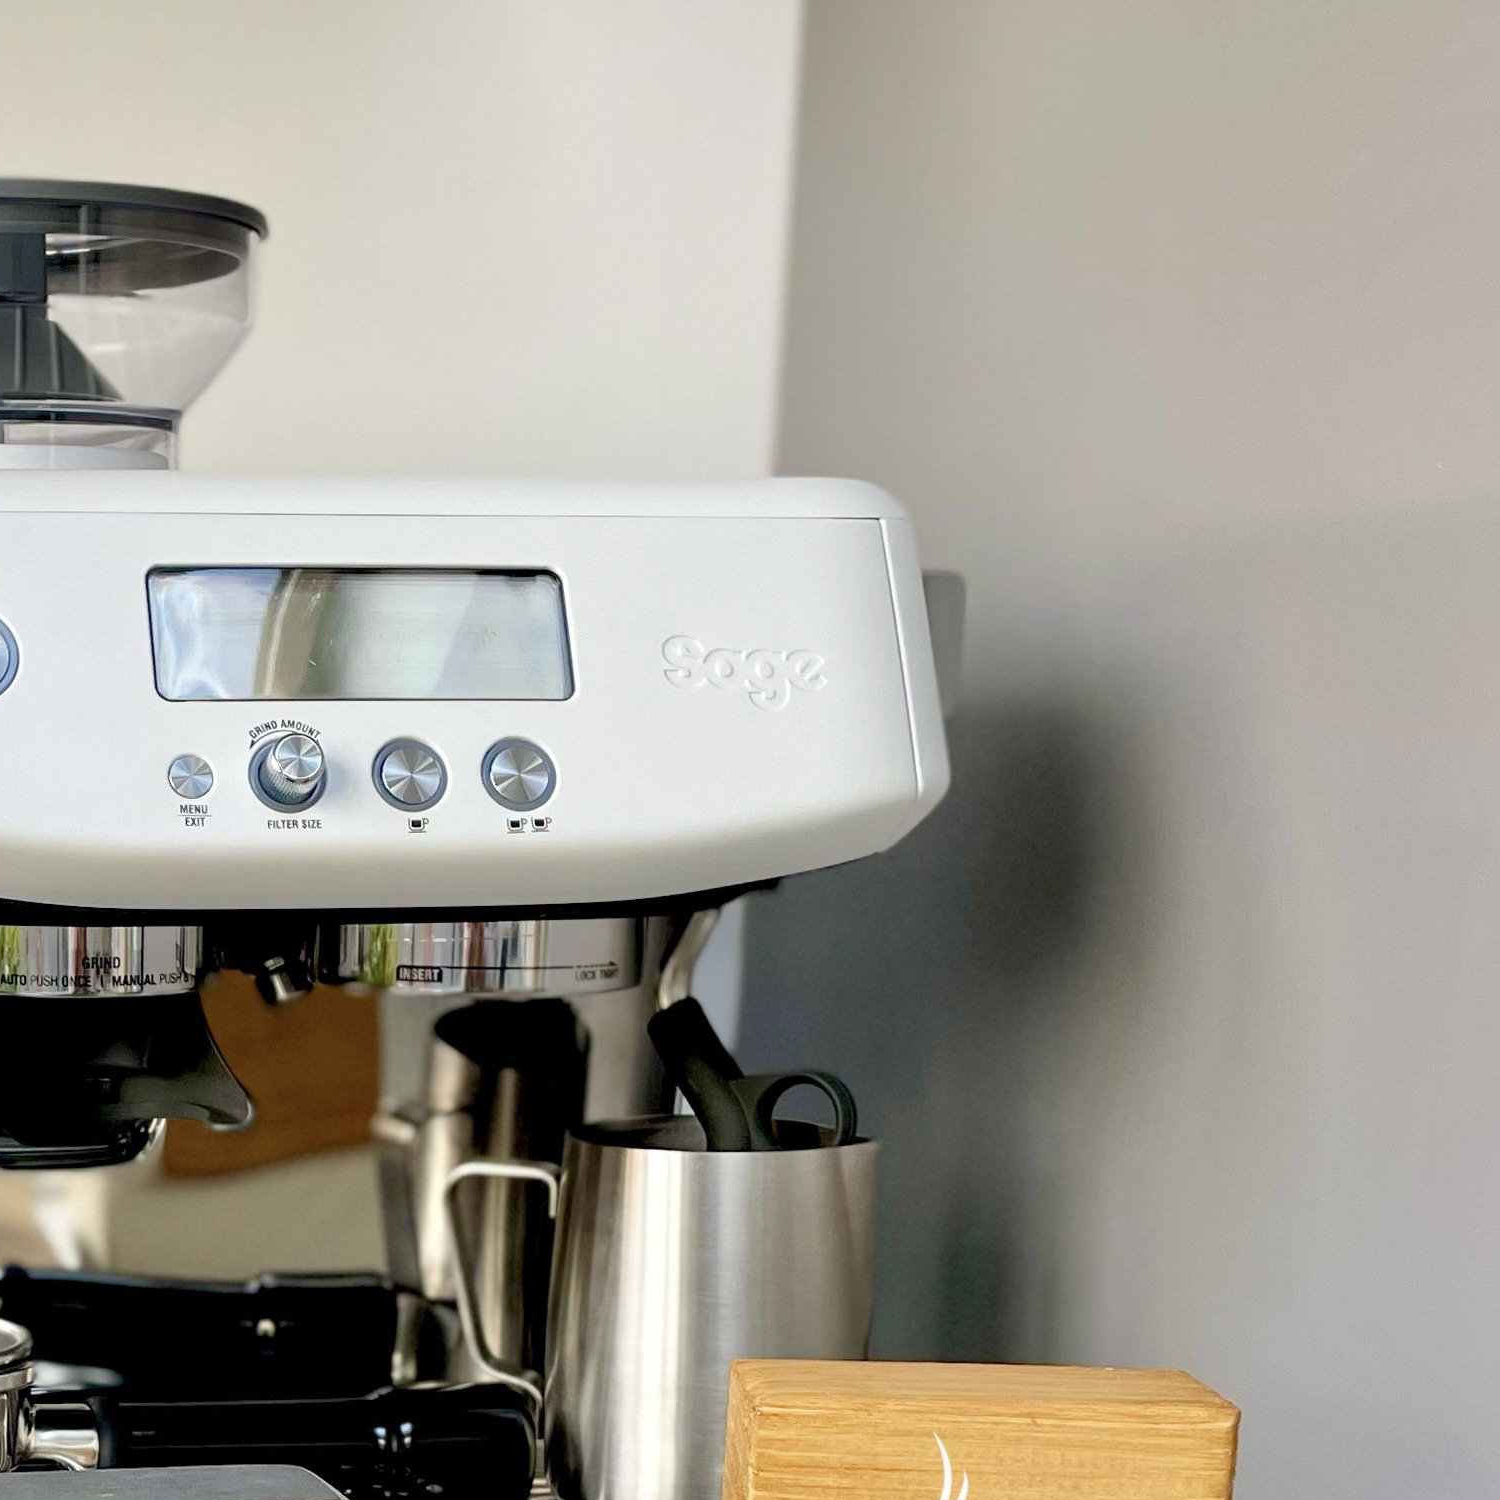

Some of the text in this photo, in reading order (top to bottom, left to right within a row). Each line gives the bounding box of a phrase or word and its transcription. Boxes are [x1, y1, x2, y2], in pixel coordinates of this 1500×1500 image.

[661, 634, 828, 711] Sage
[249, 719, 322, 739] GRIND AMOUNT
[179, 804, 208, 814] MENU
[185, 817, 206, 827] EXIT
[267, 819, 323, 829] FILTER SIZE
[82, 956, 121, 969] GRIND
[0, 974, 92, 988] AUTO PUSH ONCE
[112, 974, 156, 987] MANUAL
[399, 968, 440, 981] INSERT
